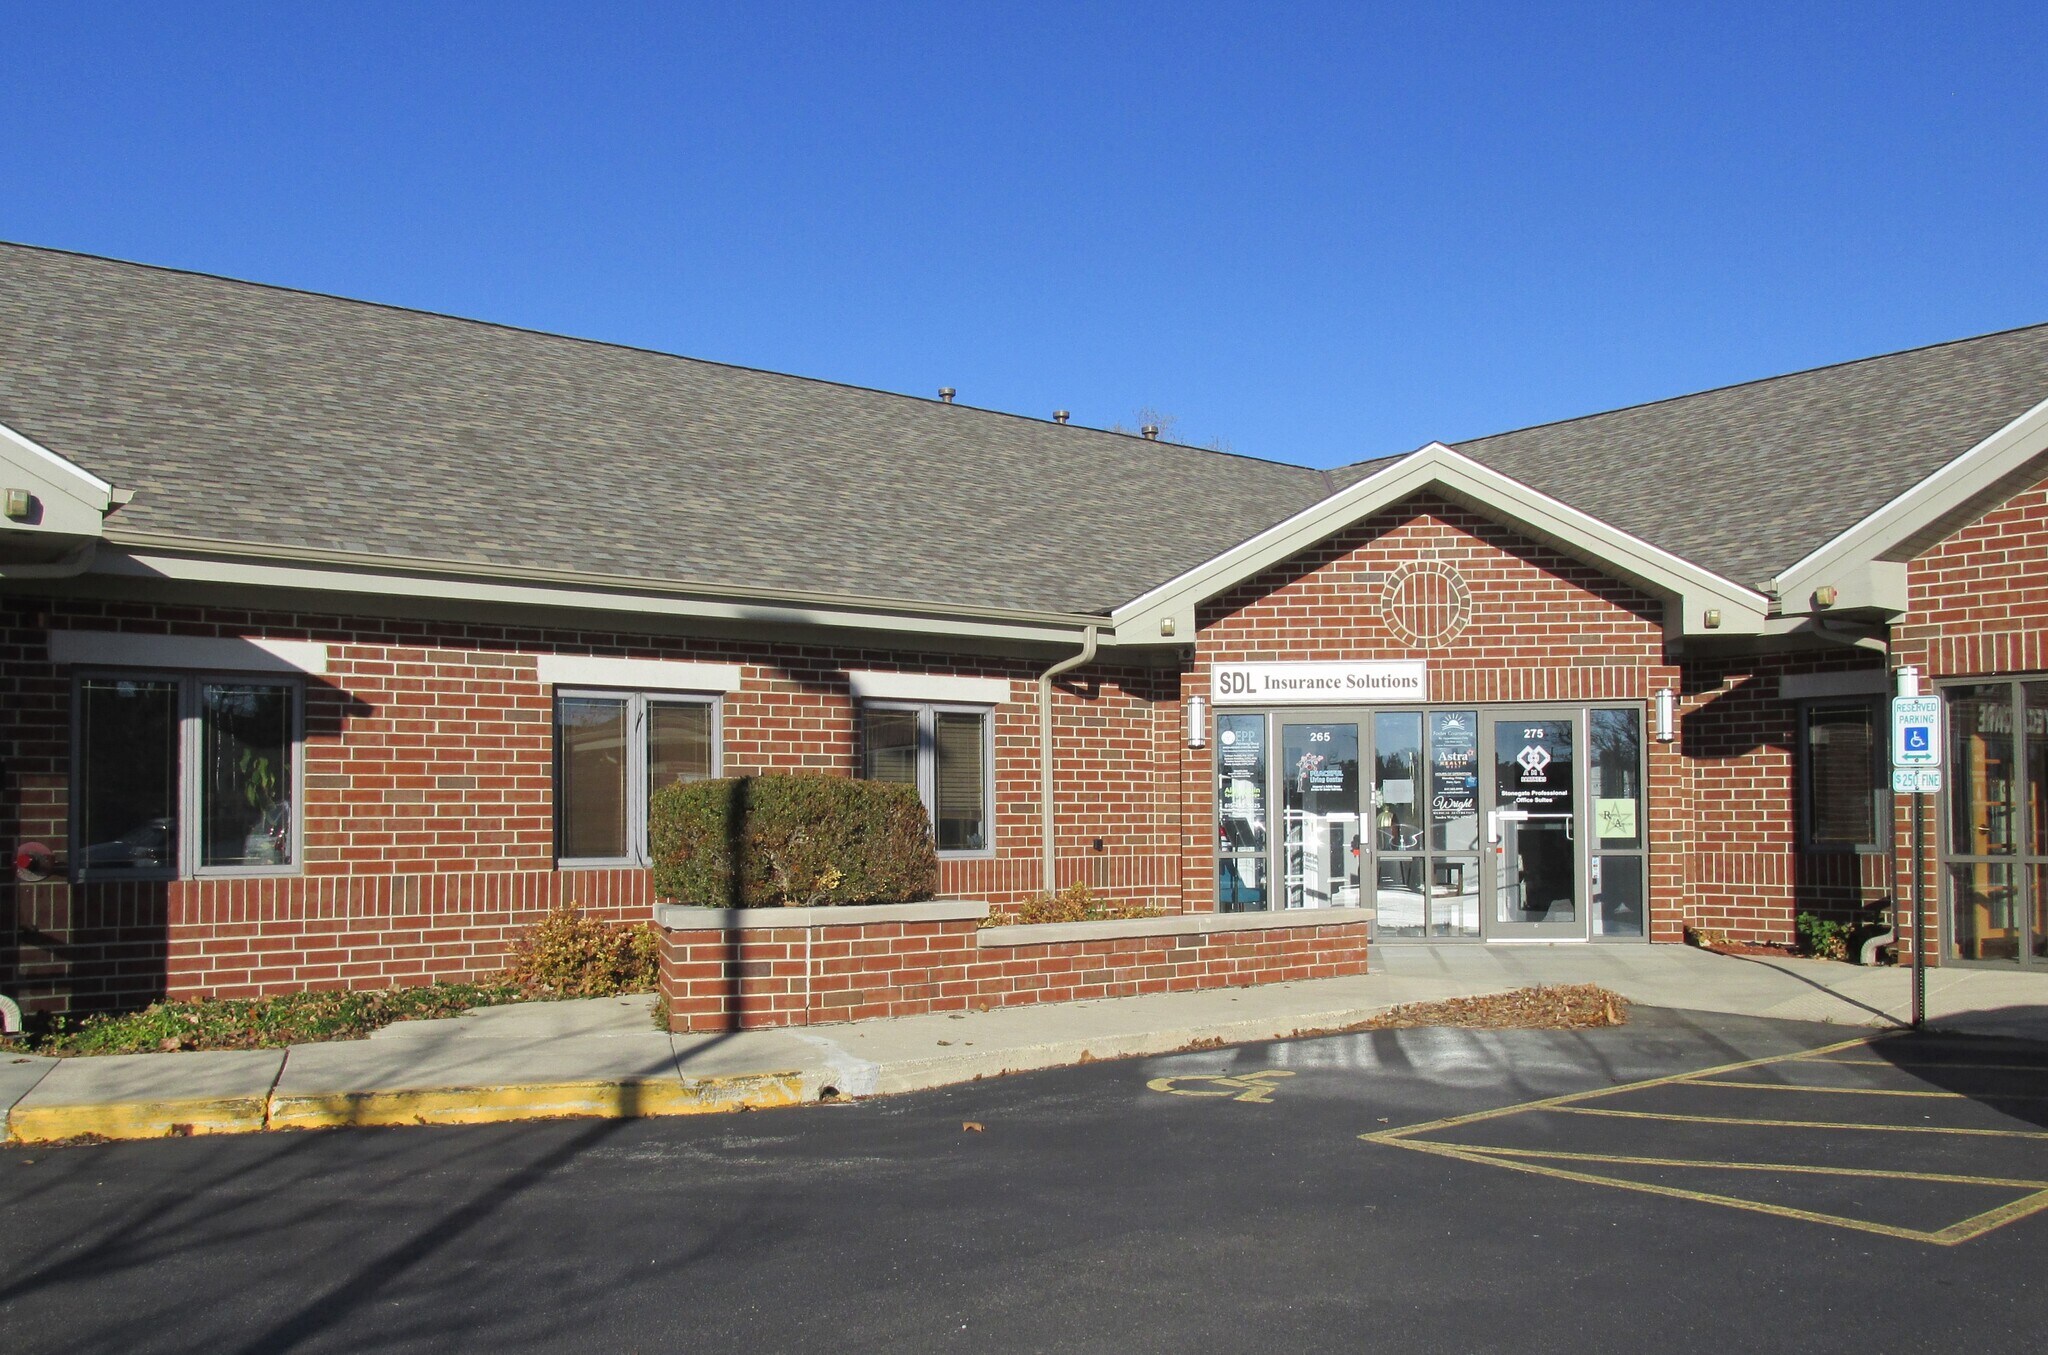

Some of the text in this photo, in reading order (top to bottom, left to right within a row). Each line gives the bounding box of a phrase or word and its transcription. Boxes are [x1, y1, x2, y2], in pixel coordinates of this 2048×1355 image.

[1219, 671, 1419, 694] SDL Insurance Solutions
[1896, 702, 1937, 712] RESERVED
[1899, 714, 1934, 724] PARKING
[1235, 730, 1255, 741] EPP
[1310, 732, 1331, 741] 265
[1523, 728, 1544, 738] 275
[1438, 751, 1468, 761] Astra
[1895, 773, 1939, 787] $ 250 FINE
[1433, 796, 1473, 811] Wright
